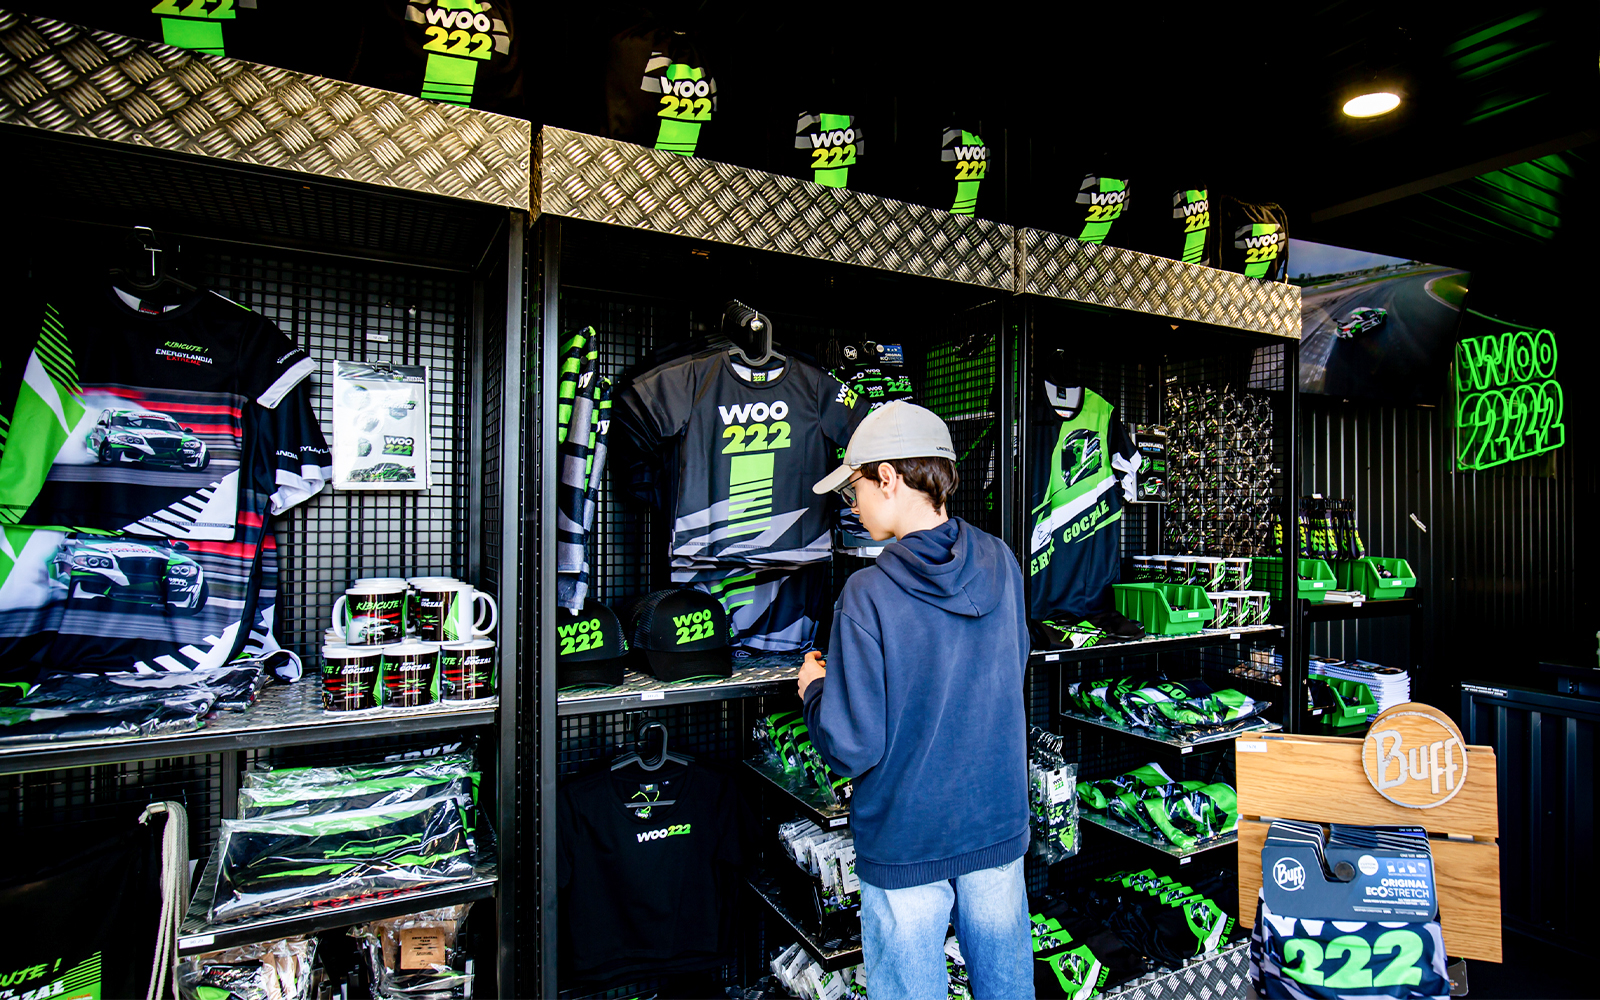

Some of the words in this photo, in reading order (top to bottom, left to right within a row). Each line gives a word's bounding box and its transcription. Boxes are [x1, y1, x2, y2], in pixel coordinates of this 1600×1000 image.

[425, 7, 491, 32] WOO
[422, 26, 493, 60] 222
[657, 95, 712, 121] 222
[811, 129, 855, 148] WOO
[811, 144, 857, 168] 222
[955, 160, 987, 180] 222
[1091, 190, 1126, 205] WOO
[1084, 203, 1124, 221] 222
[1183, 200, 1209, 216] WOO
[1184, 211, 1210, 233] 222
[1245, 233, 1279, 248] WOO
[1245, 244, 1279, 263] 222
[155, 348, 213, 364] ENERGYLANDIA
[166, 355, 202, 366] EXTREME
[1461, 329, 1558, 390] WOO
[887, 381, 913, 393] 222
[718, 400, 789, 425] WOO
[1472, 379, 1565, 471] 222
[385, 436, 413, 446] WOO
[721, 421, 791, 454] 222
[383, 443, 413, 456] 222
[355, 600, 400, 611] KIBICUTE
[557, 618, 601, 638] WOO
[673, 608, 712, 628] WOO
[676, 620, 715, 645] 222
[560, 630, 604, 656] 222
[1369, 729, 1459, 794] Buff
[1276, 863, 1303, 886] Buff
[1380, 877, 1429, 889] ORIGINAL
[1365, 886, 1430, 898] ECOSTRETCH
[1281, 929, 1424, 989] 222
[0, 963, 49, 987] UTE
